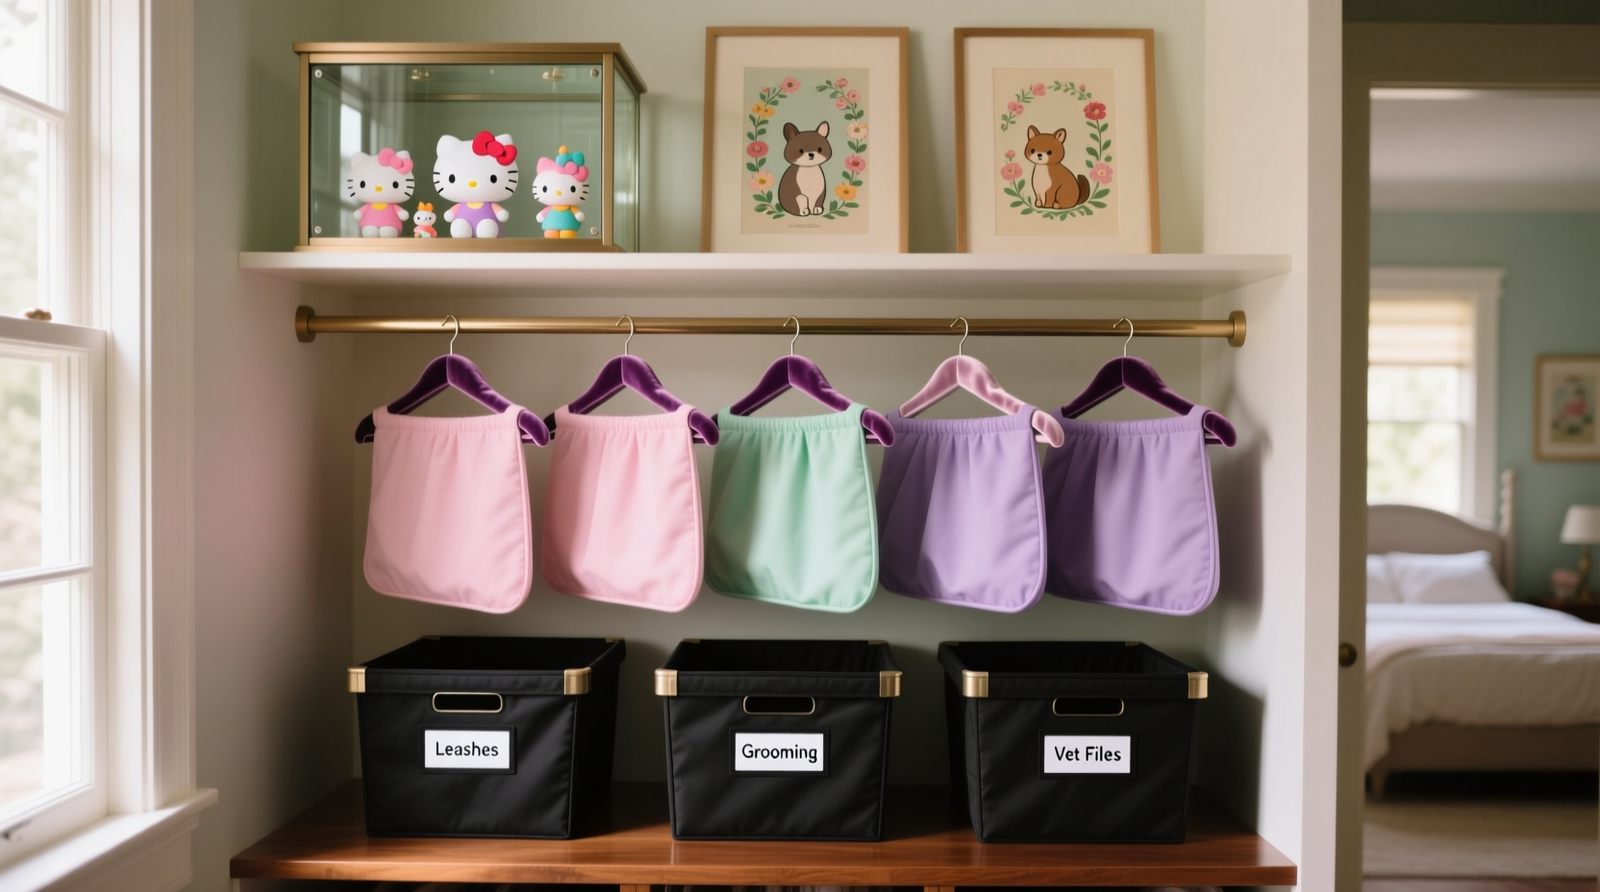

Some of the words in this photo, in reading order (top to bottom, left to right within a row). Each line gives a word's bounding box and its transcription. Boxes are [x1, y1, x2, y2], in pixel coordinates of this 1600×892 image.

[435, 741, 499, 757] Leashes
[741, 743, 818, 764] Grooming
[1054, 745, 1080, 762] Vet
[1085, 745, 1122, 762] Files
